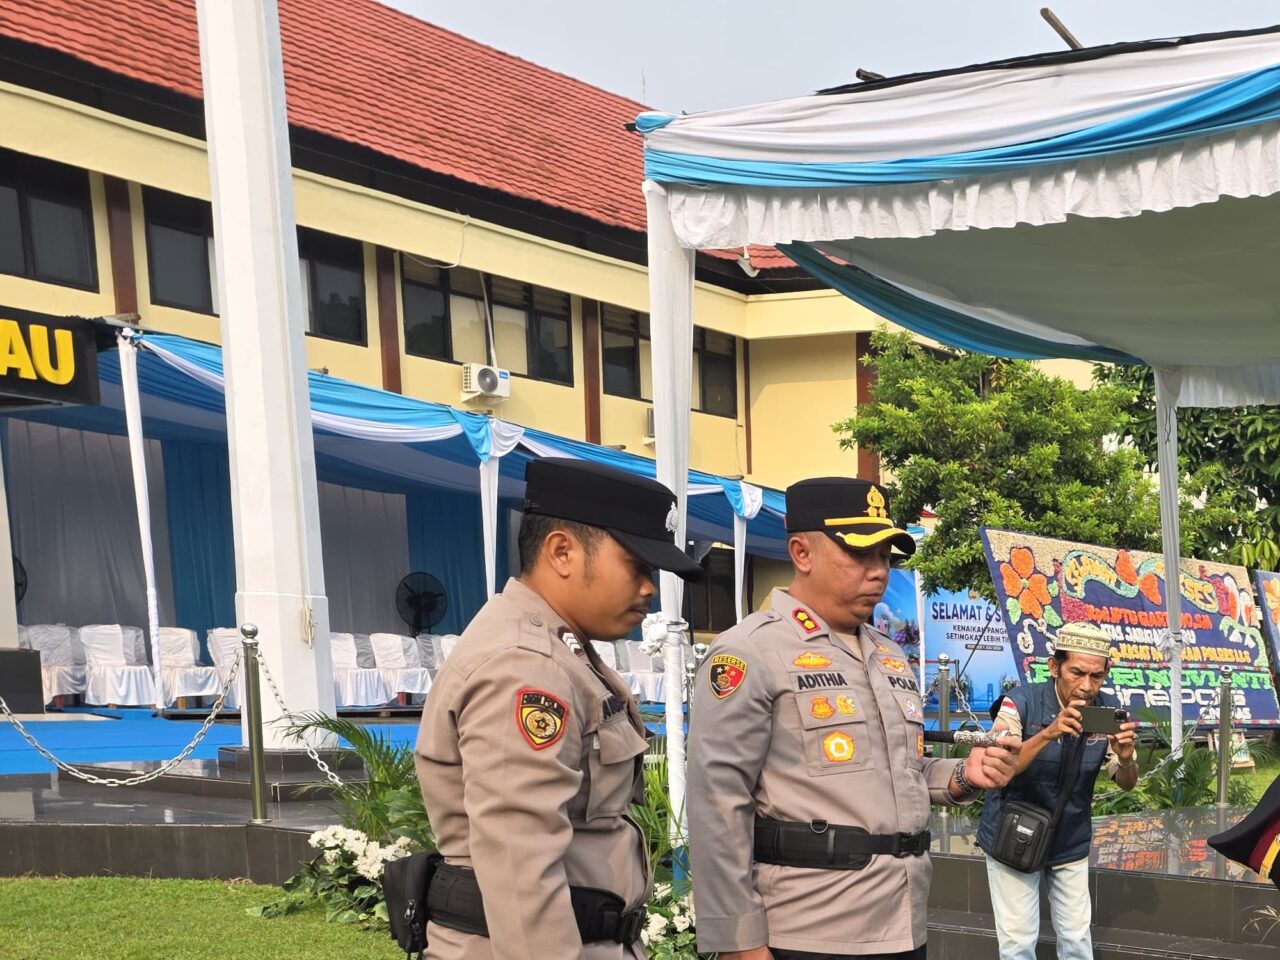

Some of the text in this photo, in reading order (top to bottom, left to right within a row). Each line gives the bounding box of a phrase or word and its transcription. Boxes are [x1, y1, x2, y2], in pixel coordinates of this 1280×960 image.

[931, 601, 982, 621] SELAMAT
[985, 606, 994, 622] &
[953, 624, 984, 635] KENAIKAN
[946, 633, 982, 643] SETINGKAT
[983, 635, 1001, 643] LEBIH
[713, 656, 745, 669] RESERSE
[797, 672, 848, 692] ADITHIA
